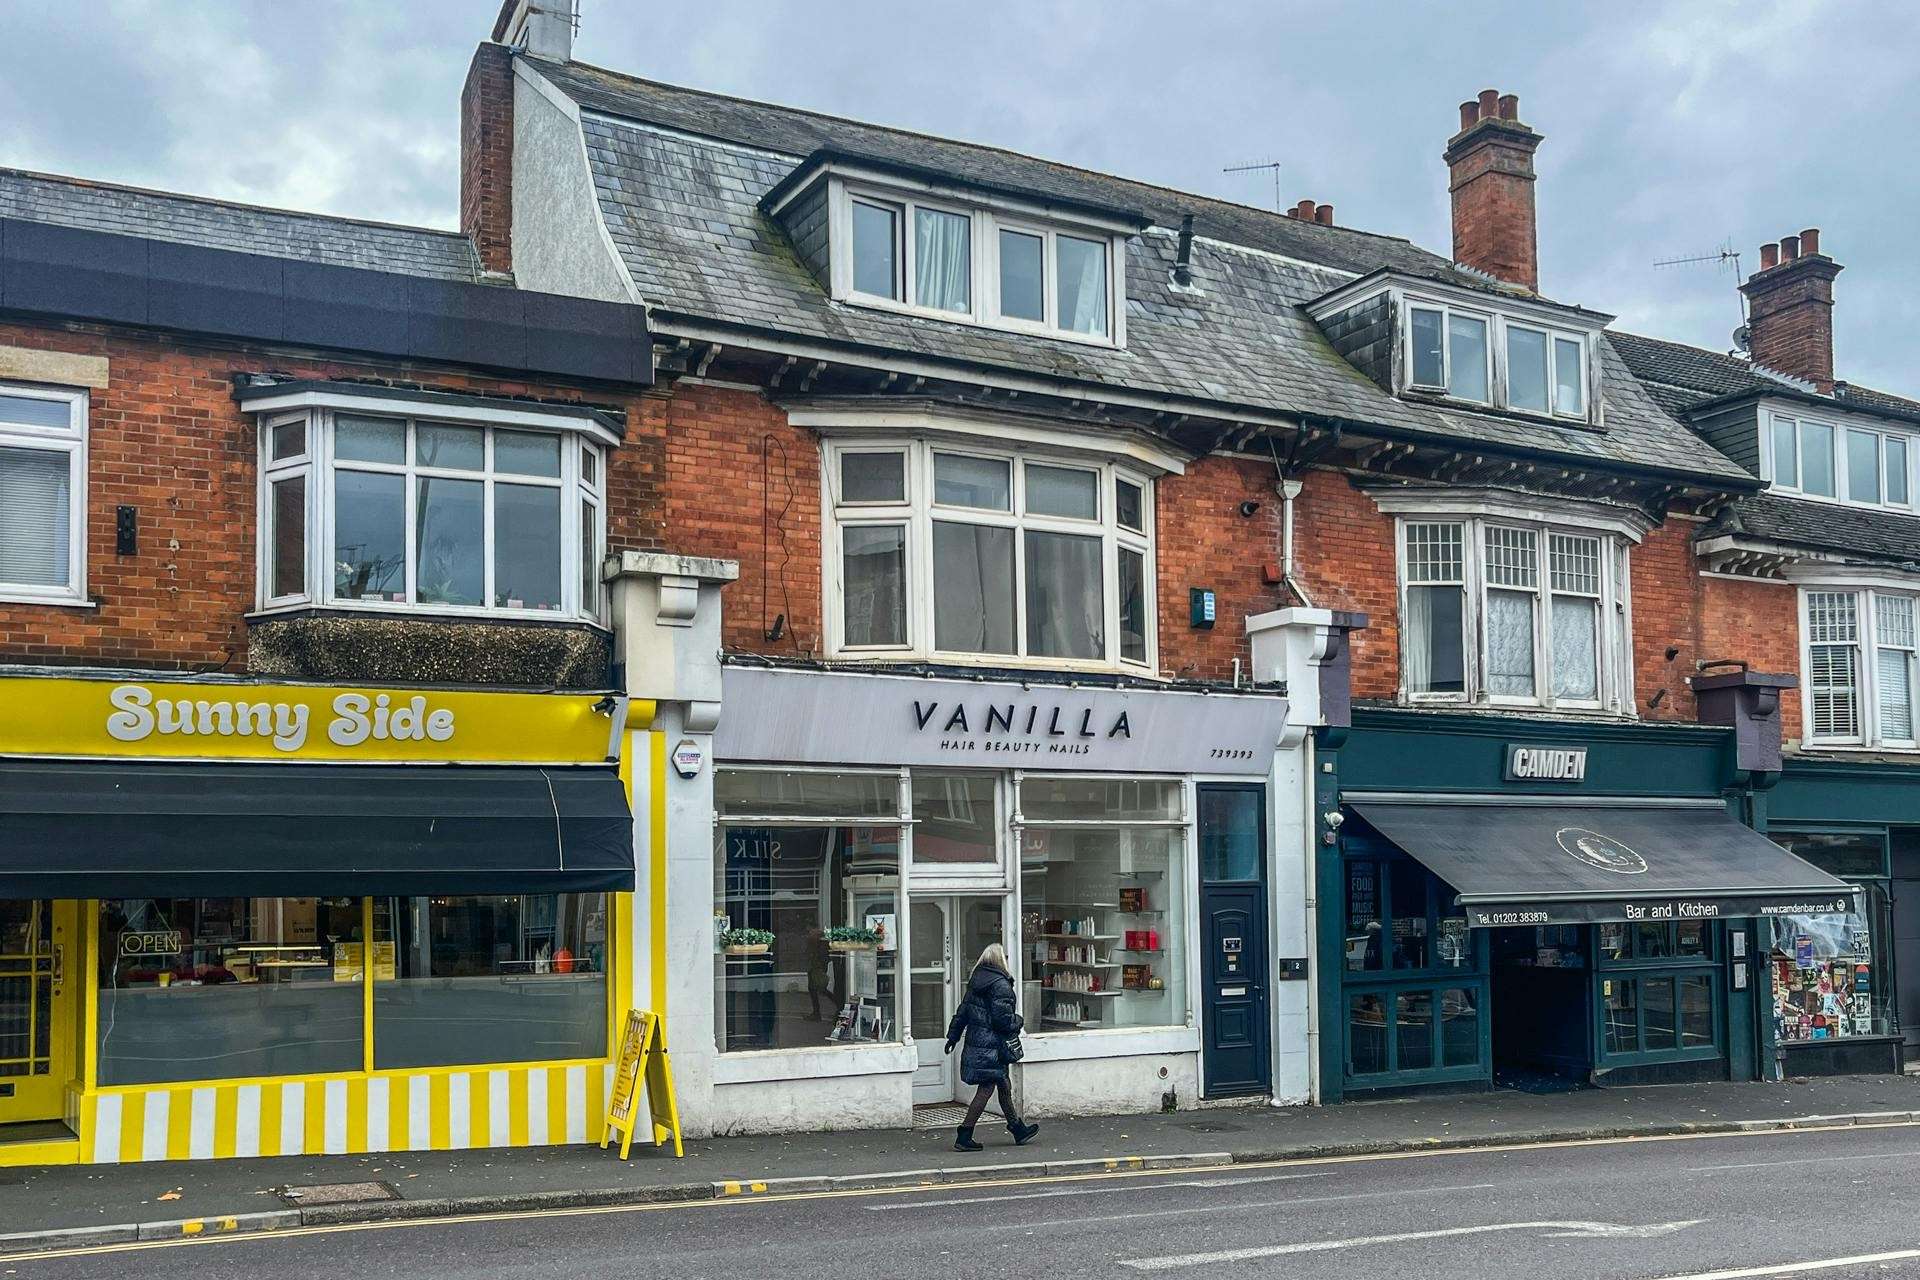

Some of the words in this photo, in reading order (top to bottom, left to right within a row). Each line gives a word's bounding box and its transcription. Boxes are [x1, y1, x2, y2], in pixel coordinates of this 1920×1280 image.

[106, 685, 310, 751] Sunny
[327, 693, 455, 746] Side
[914, 701, 1131, 738] VANILLA
[941, 740, 975, 750] HAIR
[985, 742, 1040, 752] BEAUTY
[1049, 744, 1089, 754] NAILS
[1210, 749, 1253, 759] 739393
[1512, 748, 1587, 779] CAMDEN
[1626, 904, 1646, 919] Bar
[1651, 903, 1672, 918] and
[1678, 902, 1718, 917] Kitchen
[1760, 902, 1834, 914] www.camdenbar.co.uk
[1477, 913, 1491, 924] Tel.
[1493, 912, 1517, 924] 01202
[1519, 912, 1548, 923] 383879
[125, 933, 178, 953] OPEN
[1295, 962, 1300, 970] 2
